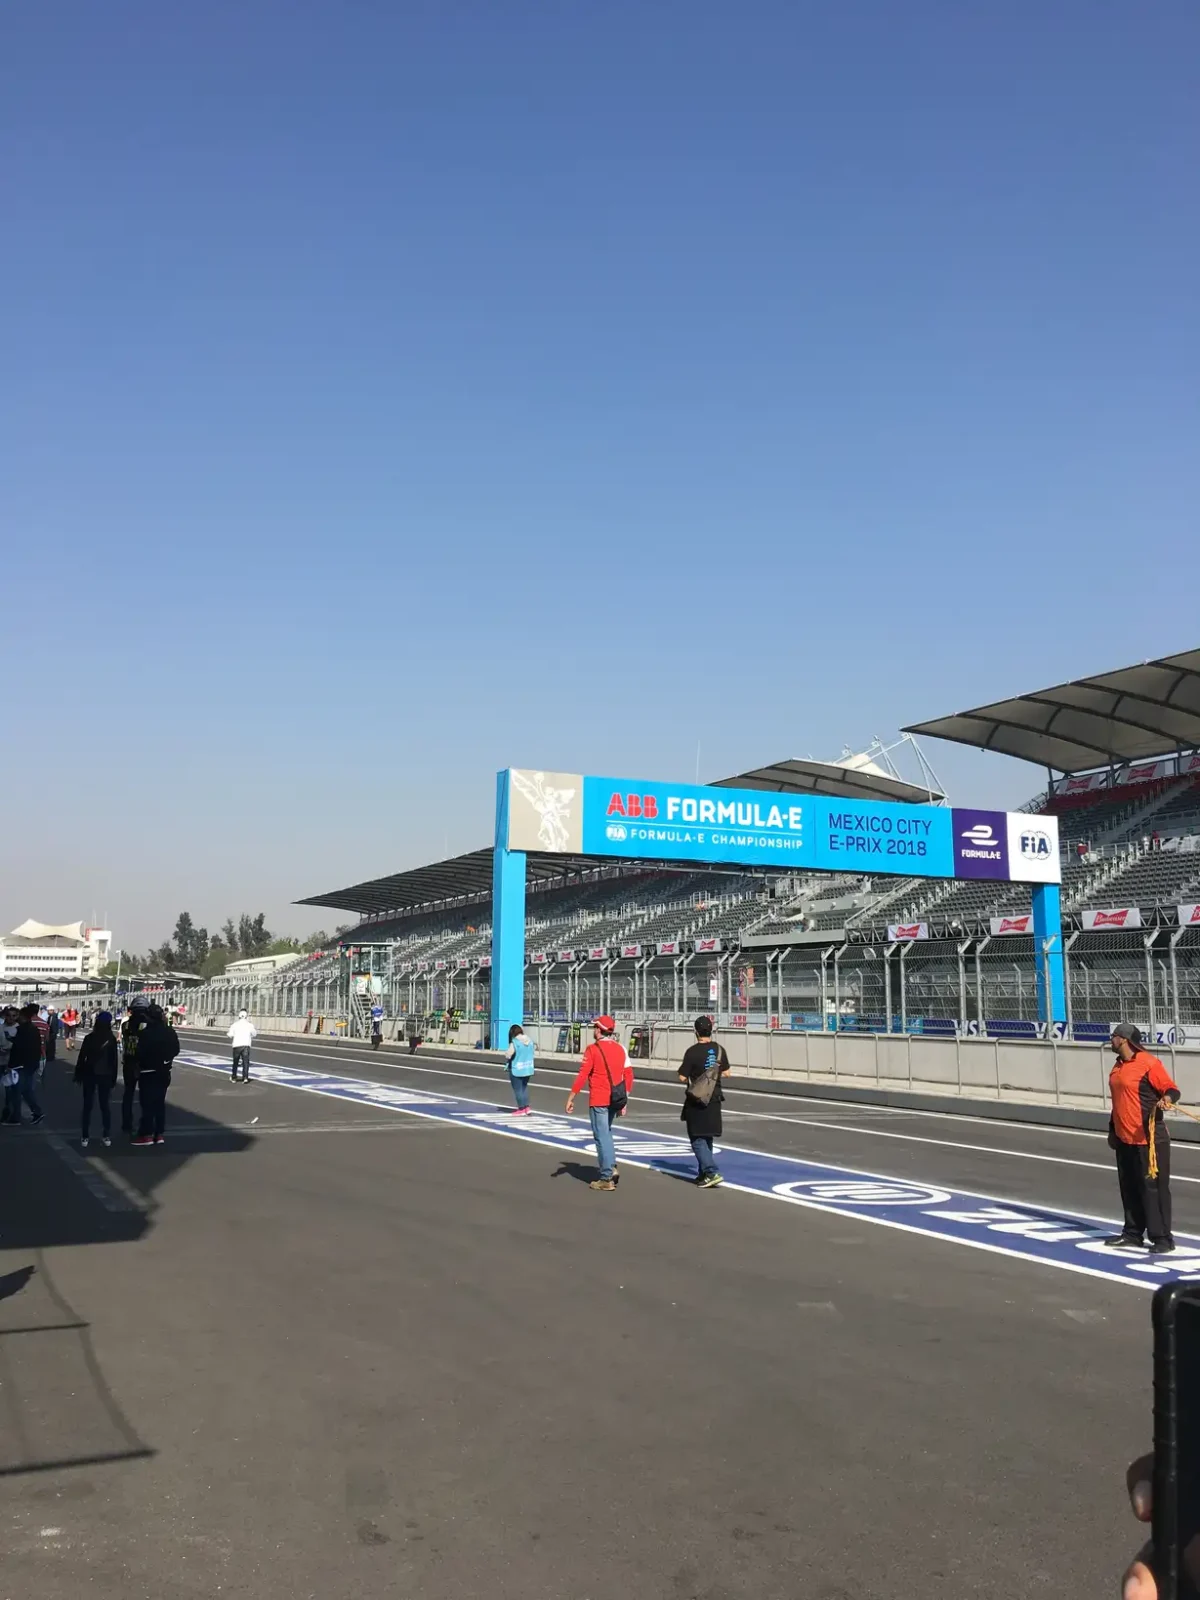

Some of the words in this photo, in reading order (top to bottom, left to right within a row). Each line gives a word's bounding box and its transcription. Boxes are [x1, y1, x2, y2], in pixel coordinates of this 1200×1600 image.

[606, 793, 658, 818] ABB
[829, 813, 892, 833] MEXICO
[897, 816, 932, 835] CITY
[712, 834, 803, 849] CHAMPIONSHIP
[829, 835, 882, 853] E-PRIX
[887, 839, 927, 856] 2018
[1031, 1022, 1074, 1040] VSA
